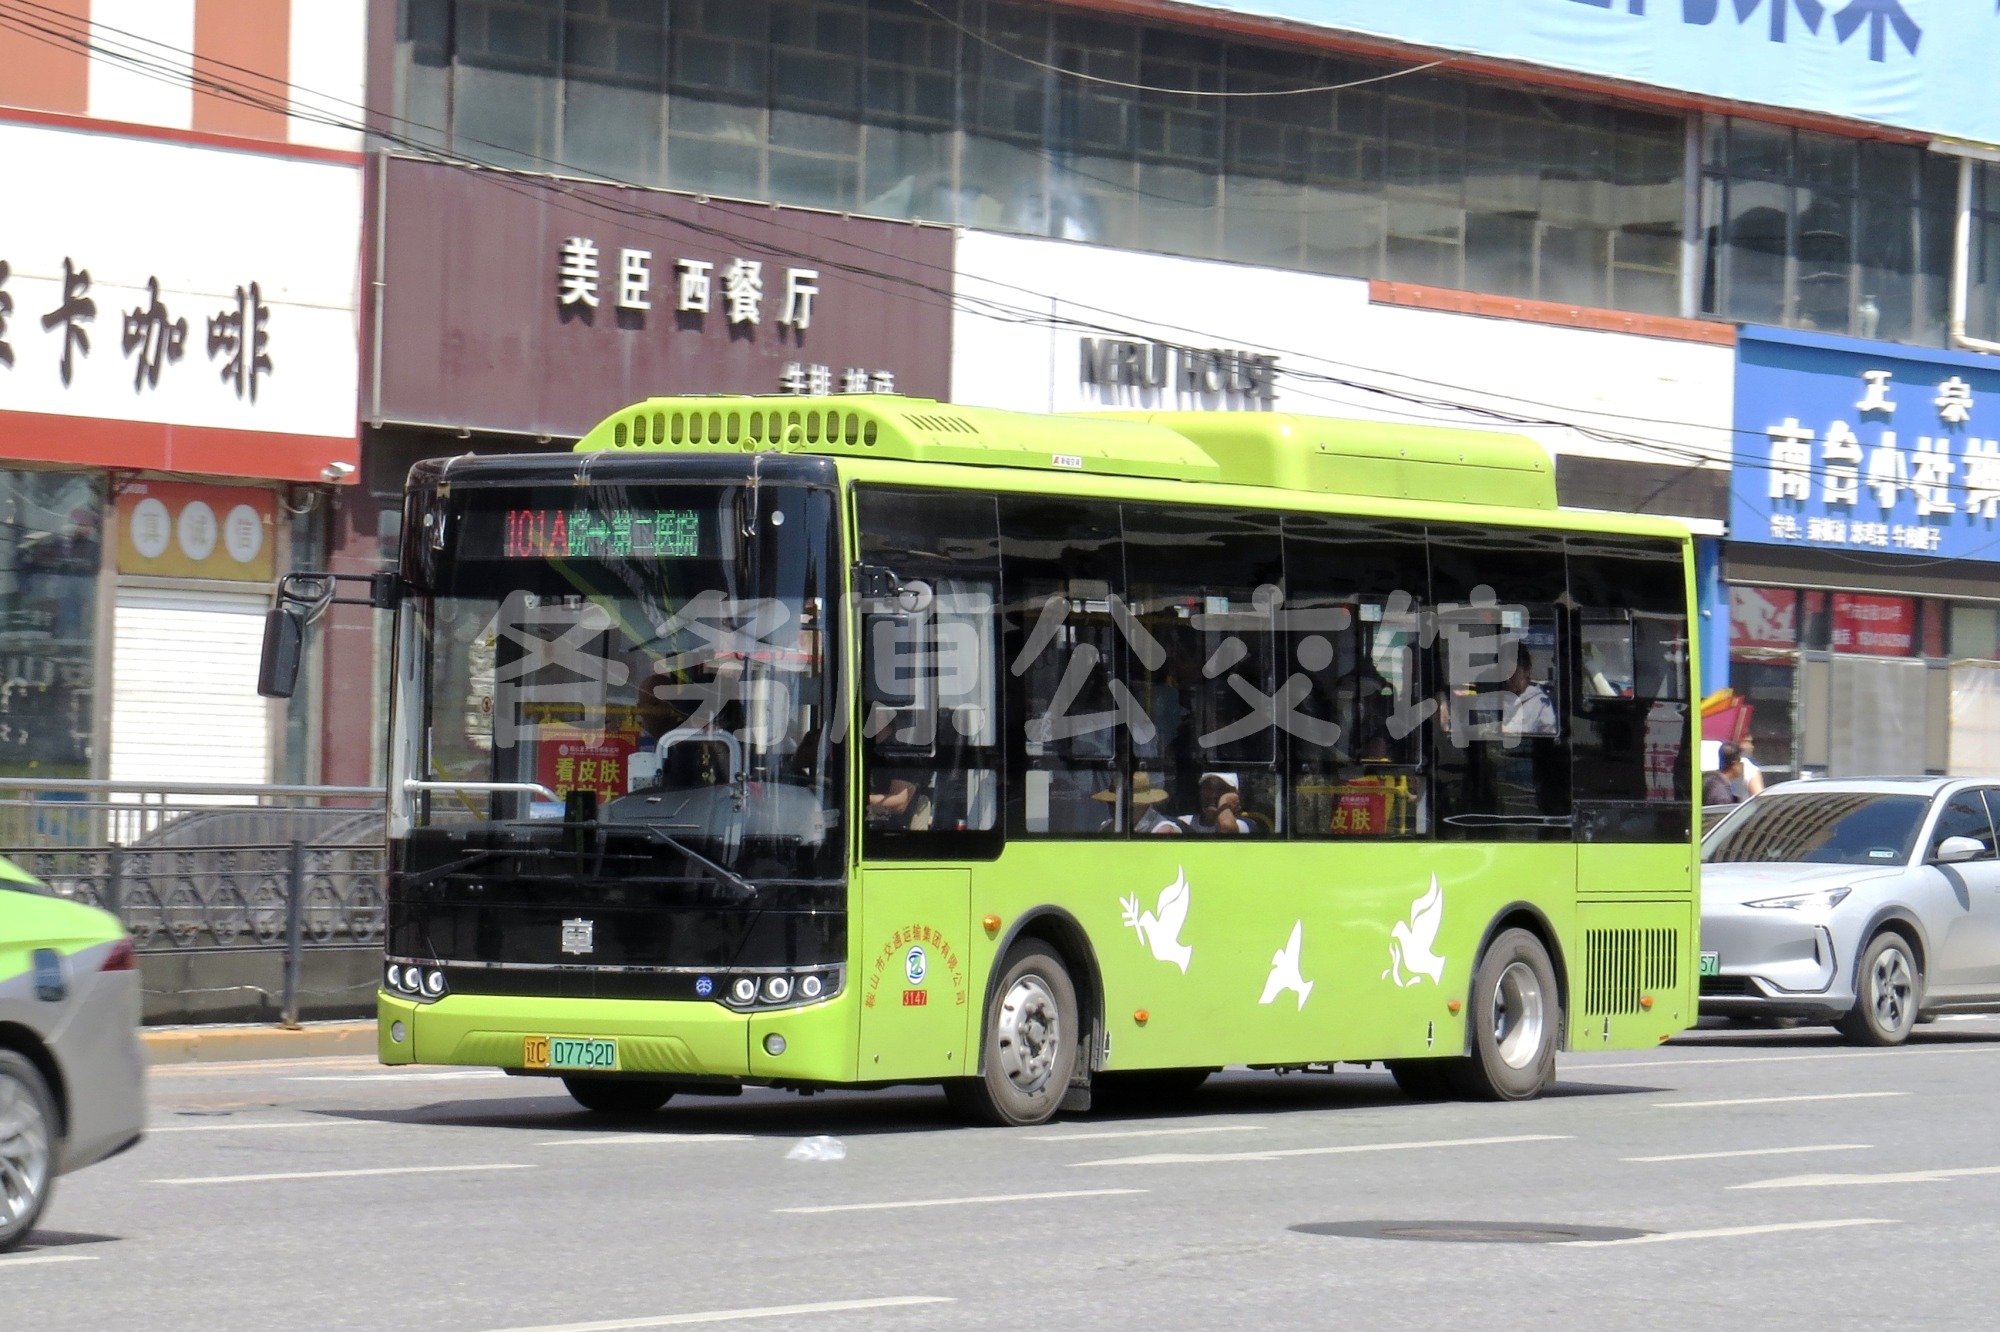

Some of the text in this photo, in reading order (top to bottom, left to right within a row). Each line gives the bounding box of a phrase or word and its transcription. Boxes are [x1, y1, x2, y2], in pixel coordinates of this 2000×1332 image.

[560, 237, 820, 330] 美臣西餐厅
[0, 255, 273, 406] 卡咖啡
[508, 510, 569, 557] 101A
[555, 757, 620, 783] 看皮肤
[904, 991, 926, 1005] 3147
